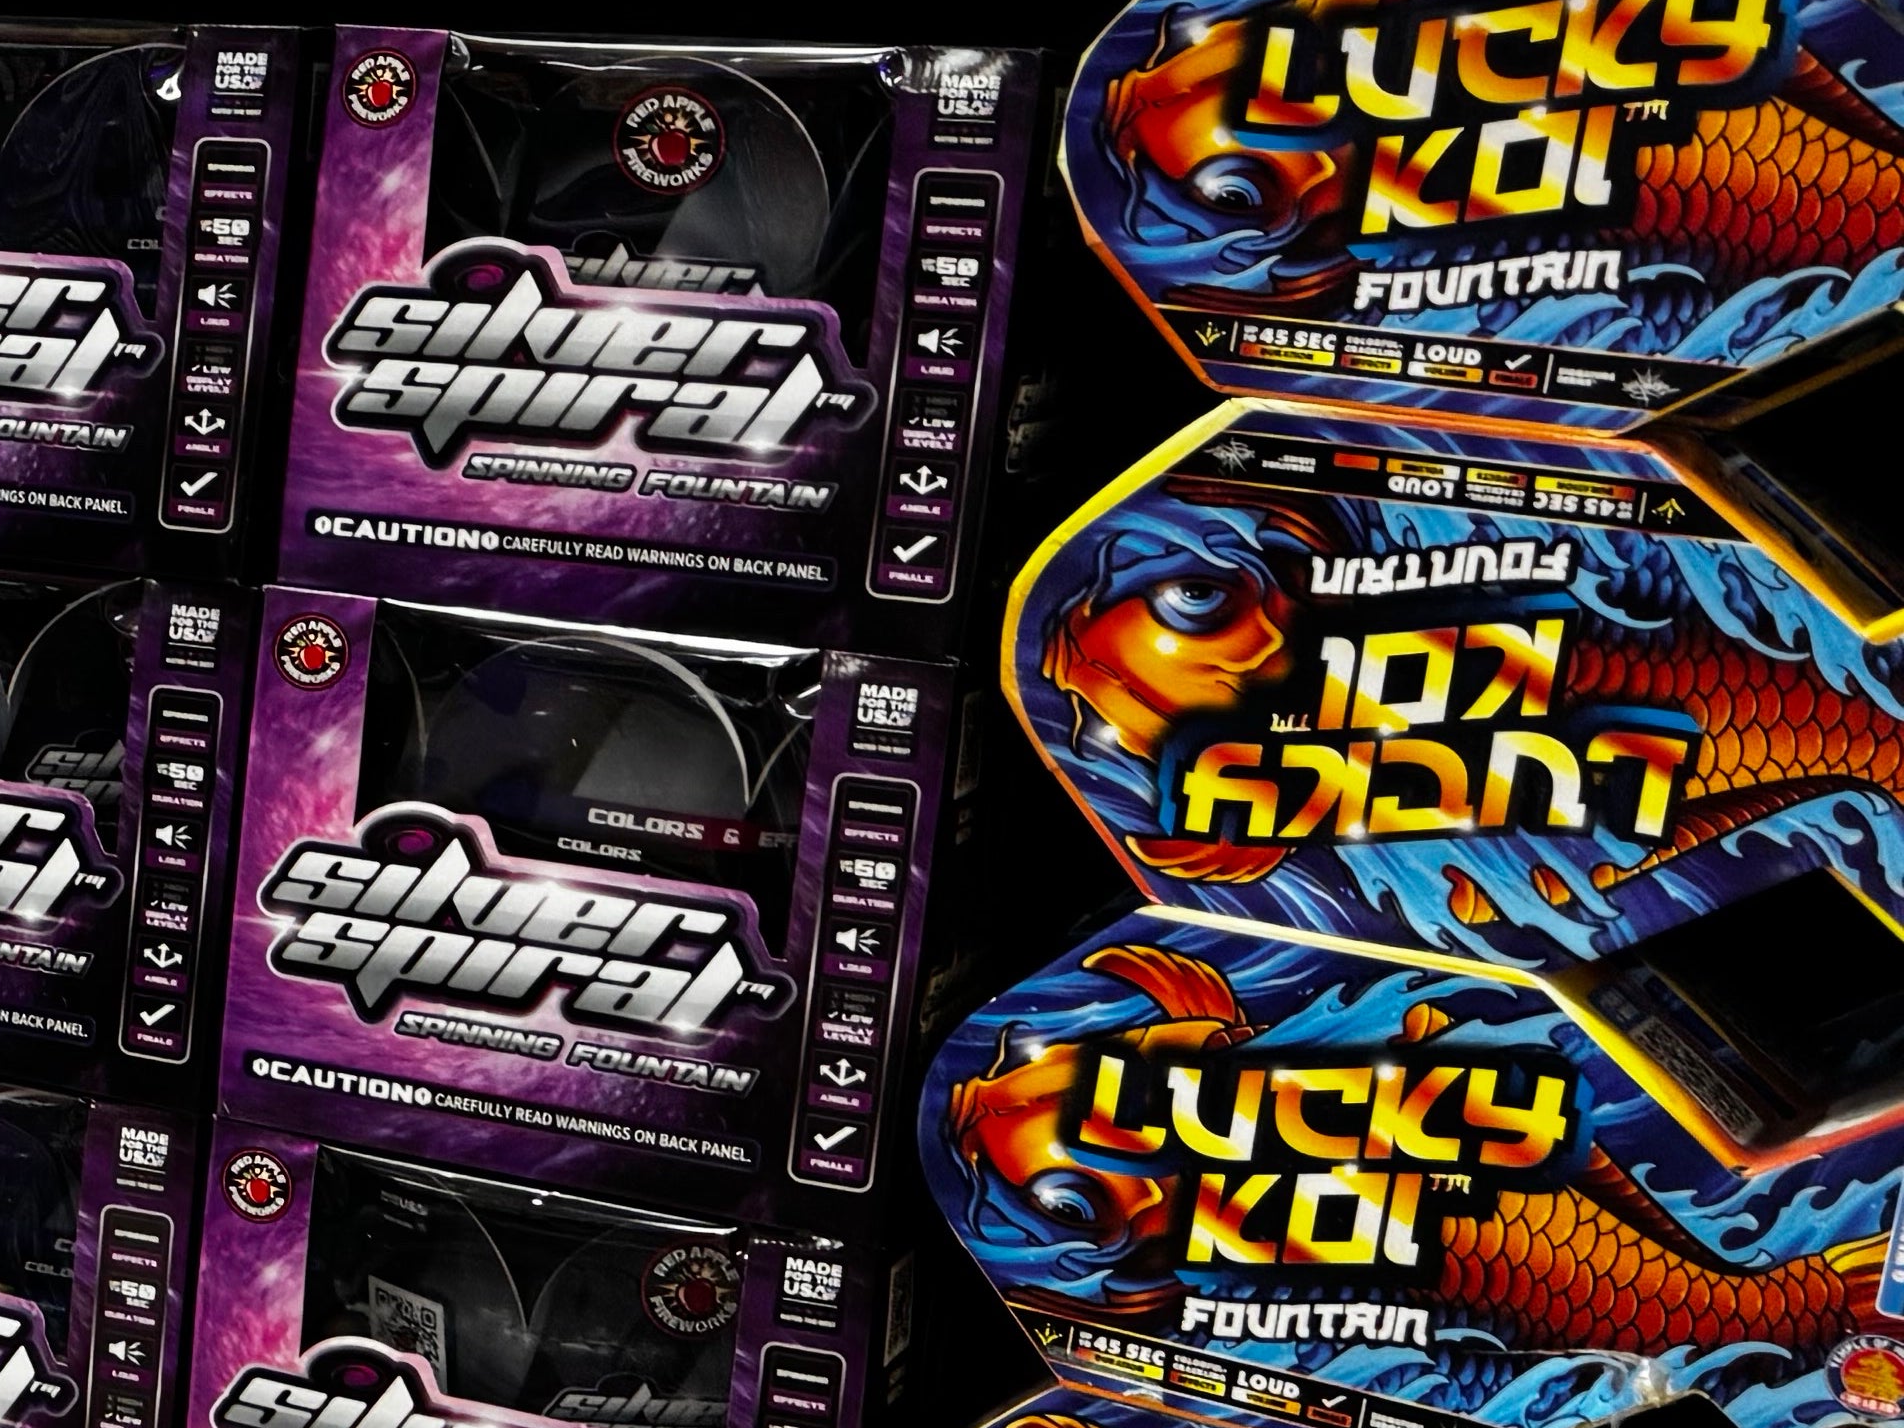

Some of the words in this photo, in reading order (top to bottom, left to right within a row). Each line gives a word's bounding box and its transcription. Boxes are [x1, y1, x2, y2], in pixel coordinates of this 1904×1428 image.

[626, 94, 661, 132] RED
[660, 94, 714, 134] APPLE
[622, 146, 714, 190] FIREWORKS
[1360, 106, 1614, 235] KOI
[1354, 250, 1622, 310] FOUNTAIN
[1258, 326, 1291, 348] 45
[1292, 329, 1336, 352] SEC
[1414, 342, 1482, 366] LOUD
[1312, 542, 1573, 596] FOUNTAIN
[1318, 618, 1566, 733] KOI
[1183, 729, 1689, 840] LUCKY
[396, 1011, 561, 1058] SPINNING
[570, 1042, 751, 1092] FOUNTAIN
[270, 1063, 416, 1103] CAUTION
[434, 1093, 513, 1122] CAREFULLY
[516, 1105, 552, 1127] READ
[556, 1113, 632, 1140] WARNINGS
[634, 1126, 657, 1143] ON
[660, 1130, 698, 1152] BACK
